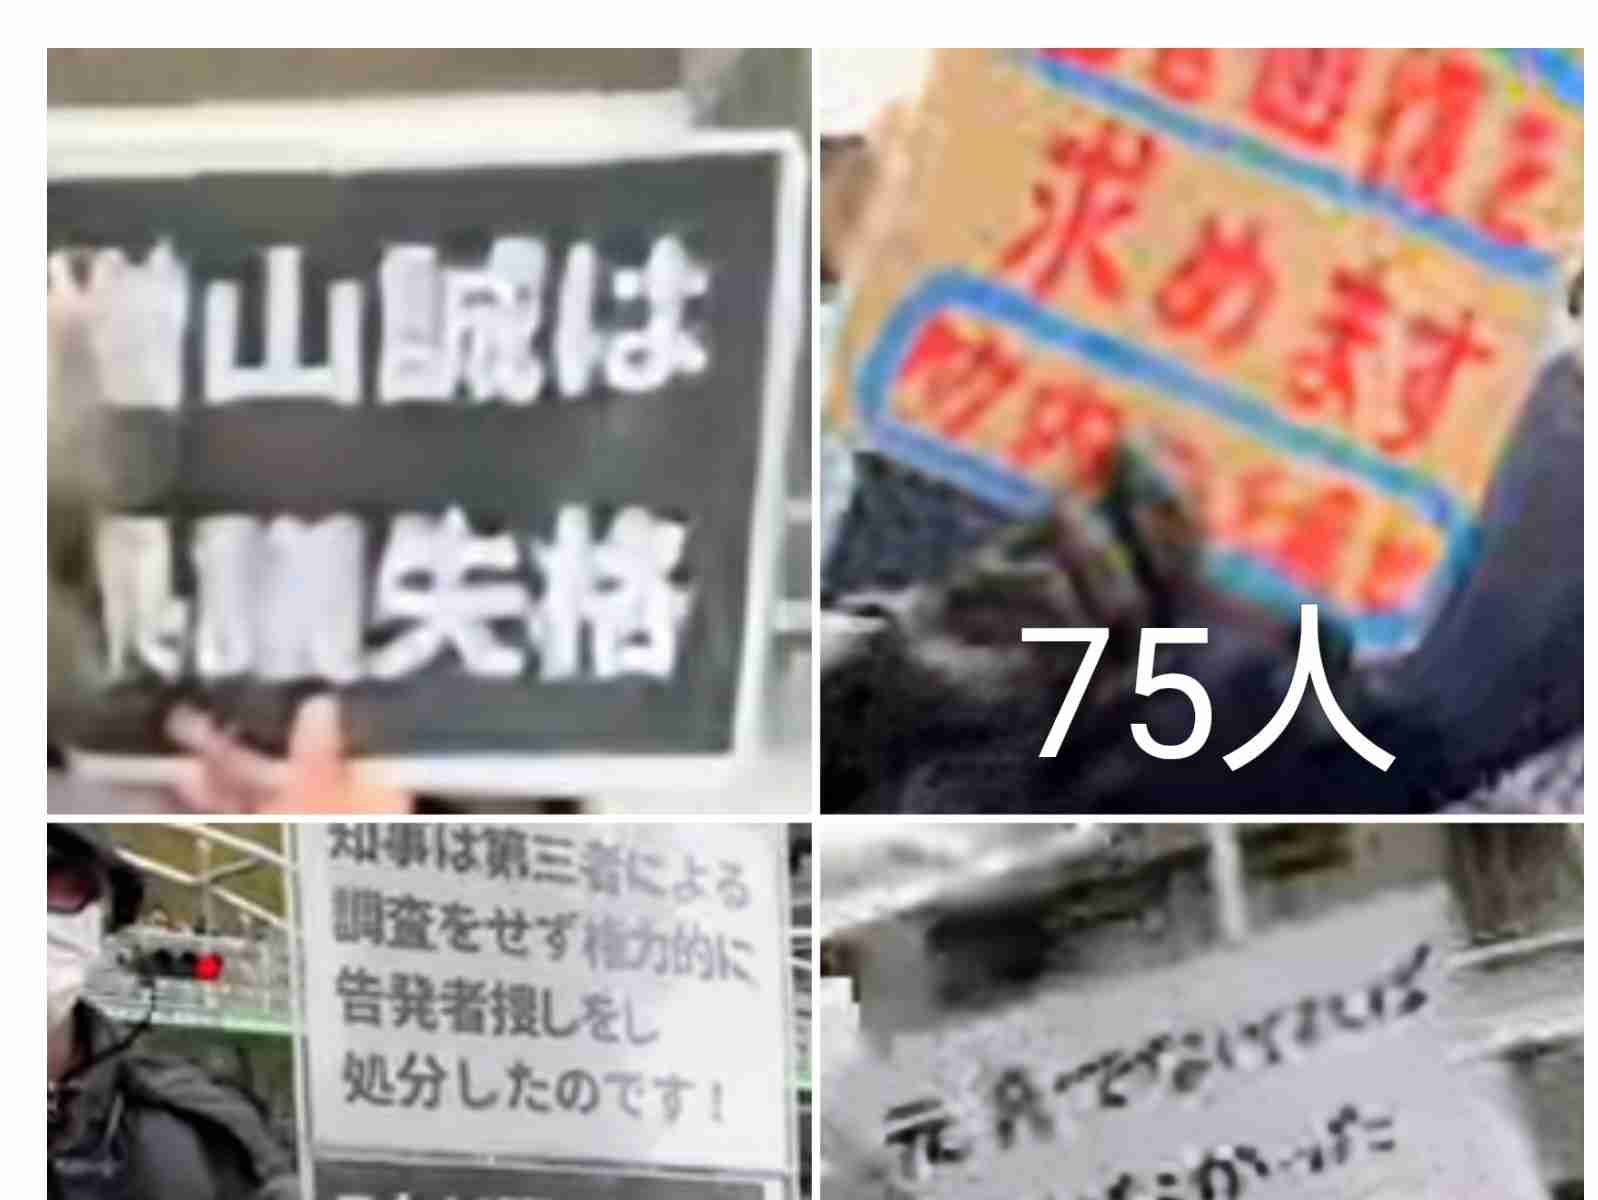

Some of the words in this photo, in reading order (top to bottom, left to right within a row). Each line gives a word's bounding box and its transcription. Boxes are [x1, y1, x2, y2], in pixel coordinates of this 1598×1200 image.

[996, 118, 1492, 454] 求めます
[326, 823, 754, 912] 知事は第三者による
[331, 886, 760, 990] 調査をせず権力的に
